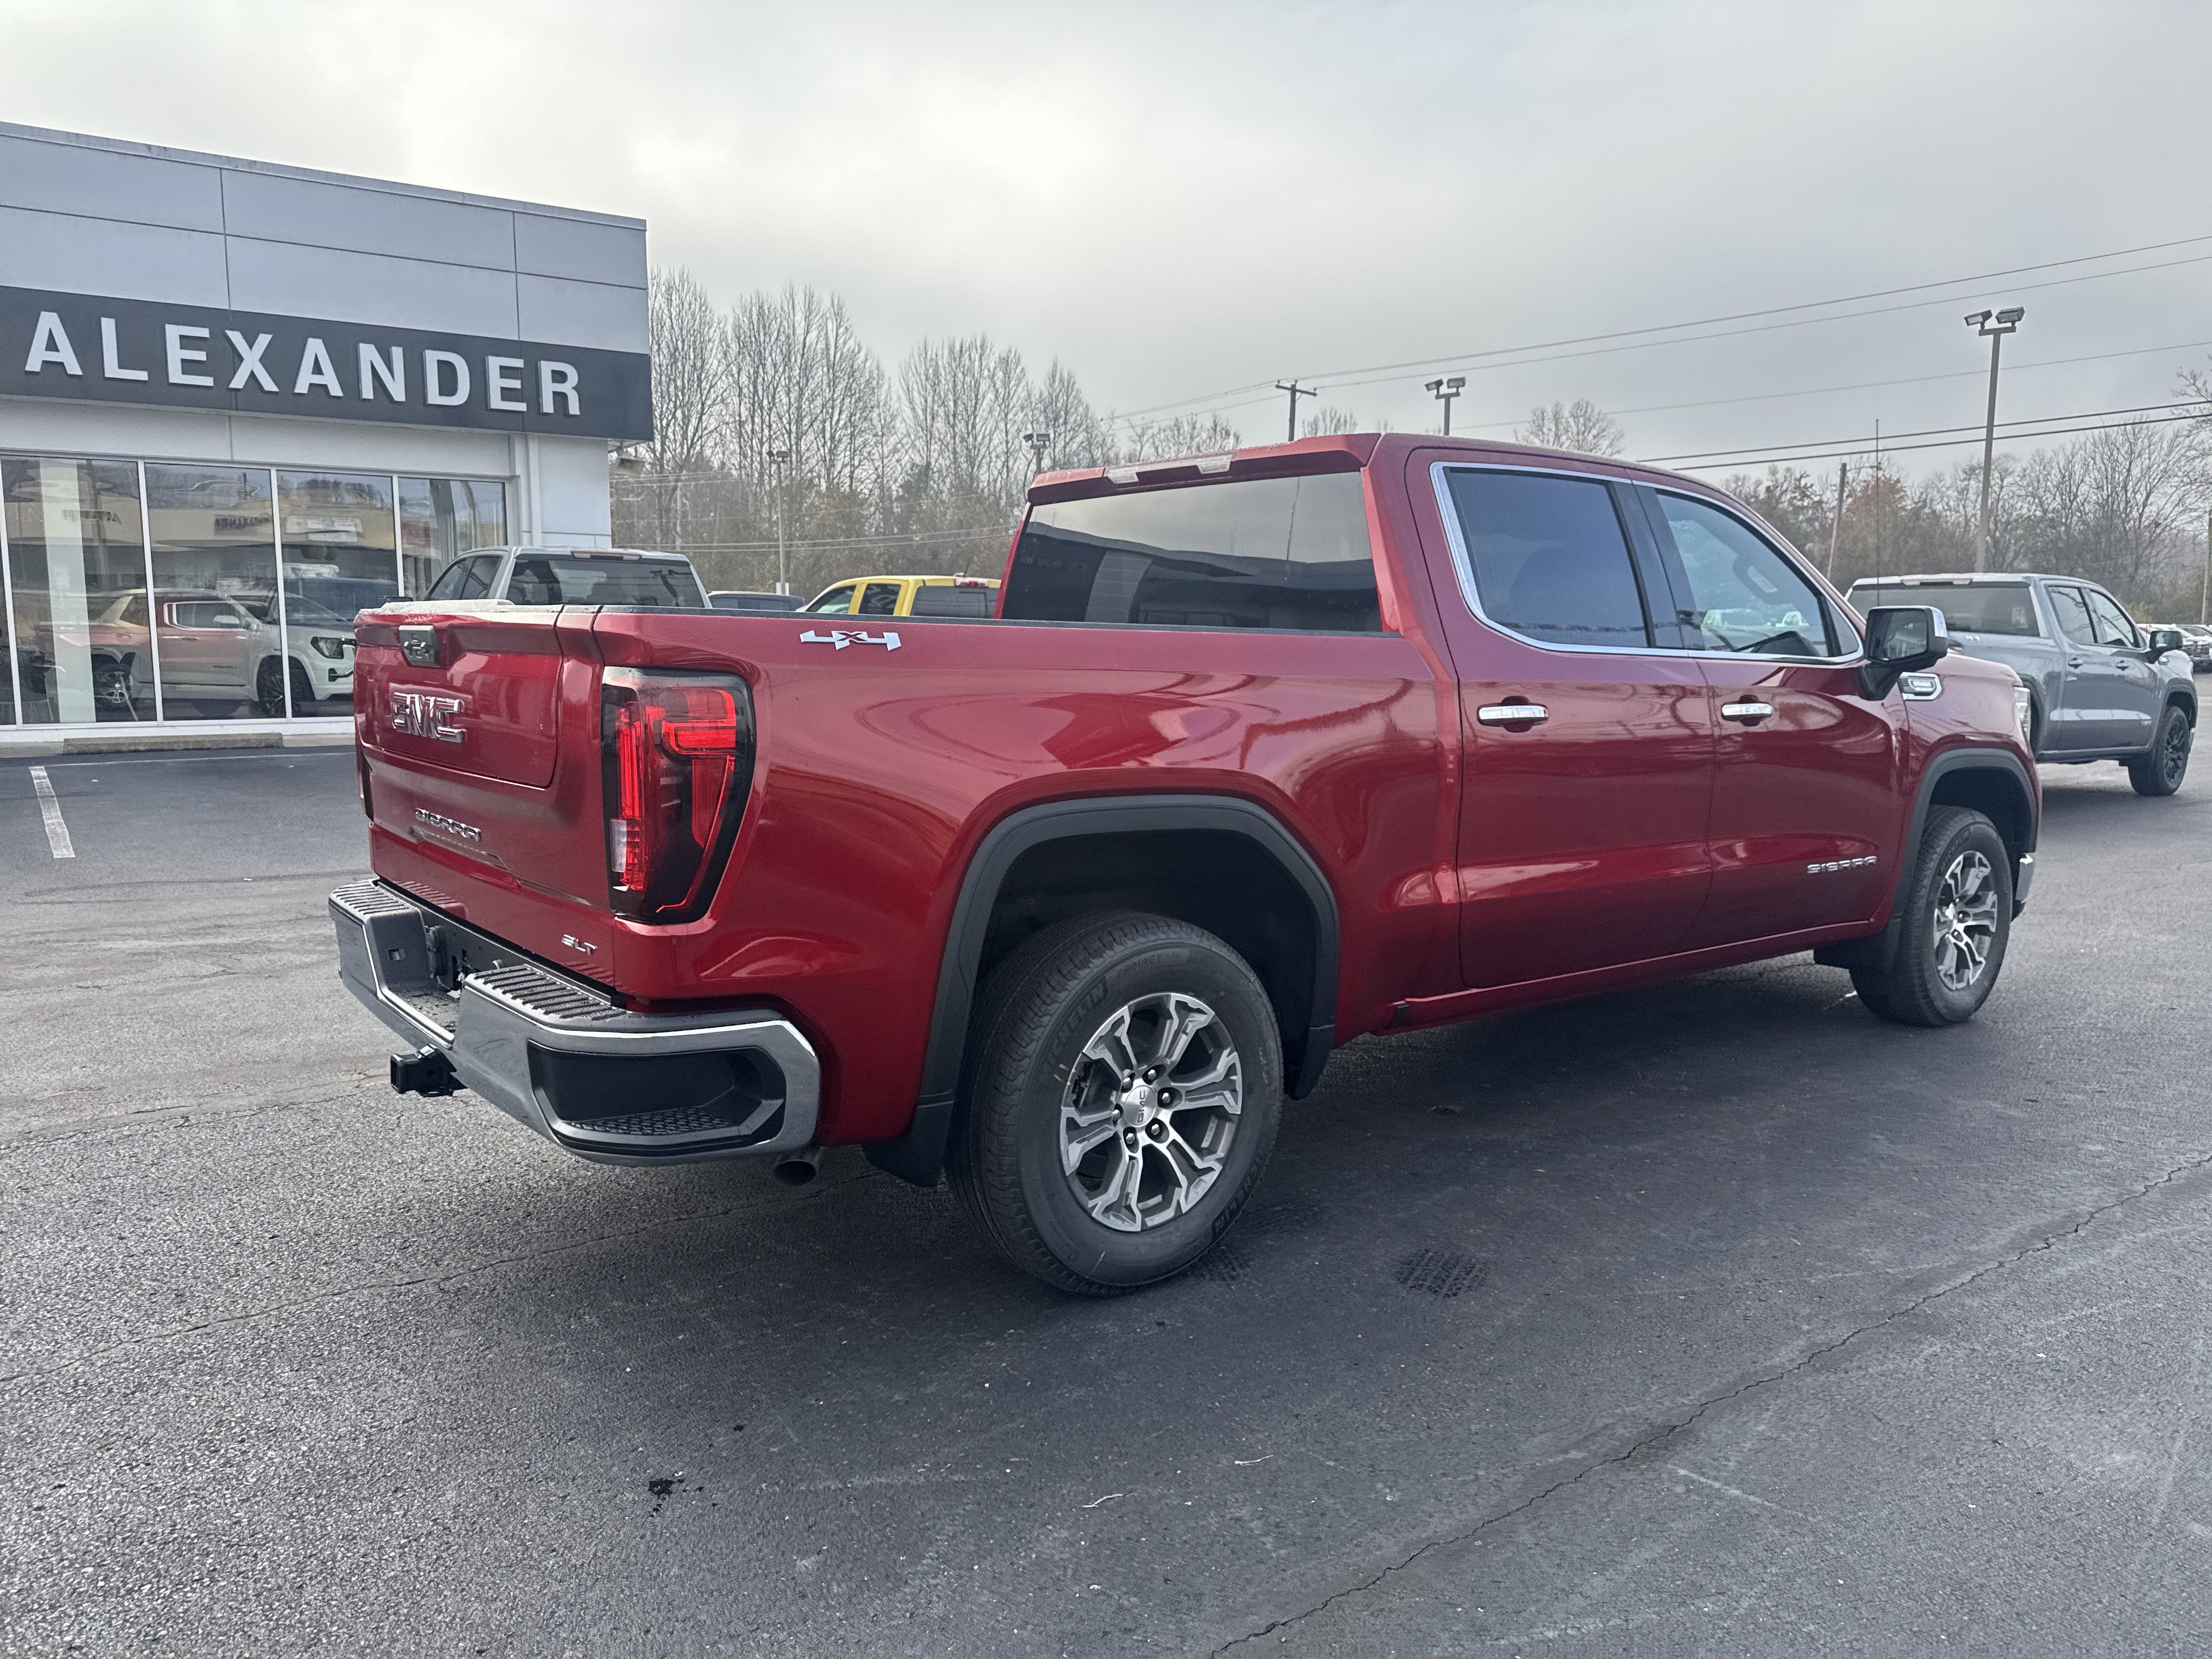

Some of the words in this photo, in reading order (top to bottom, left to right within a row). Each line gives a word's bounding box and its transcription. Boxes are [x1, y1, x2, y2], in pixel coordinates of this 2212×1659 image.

[25, 311, 581, 415] ALEXANDER
[391, 692, 466, 743] GMC
[415, 808, 482, 842] SIERRA
[1807, 855, 1877, 873] SIERRA
[562, 934, 597, 955] SLT
[1137, 1090, 1146, 1123] GMC
